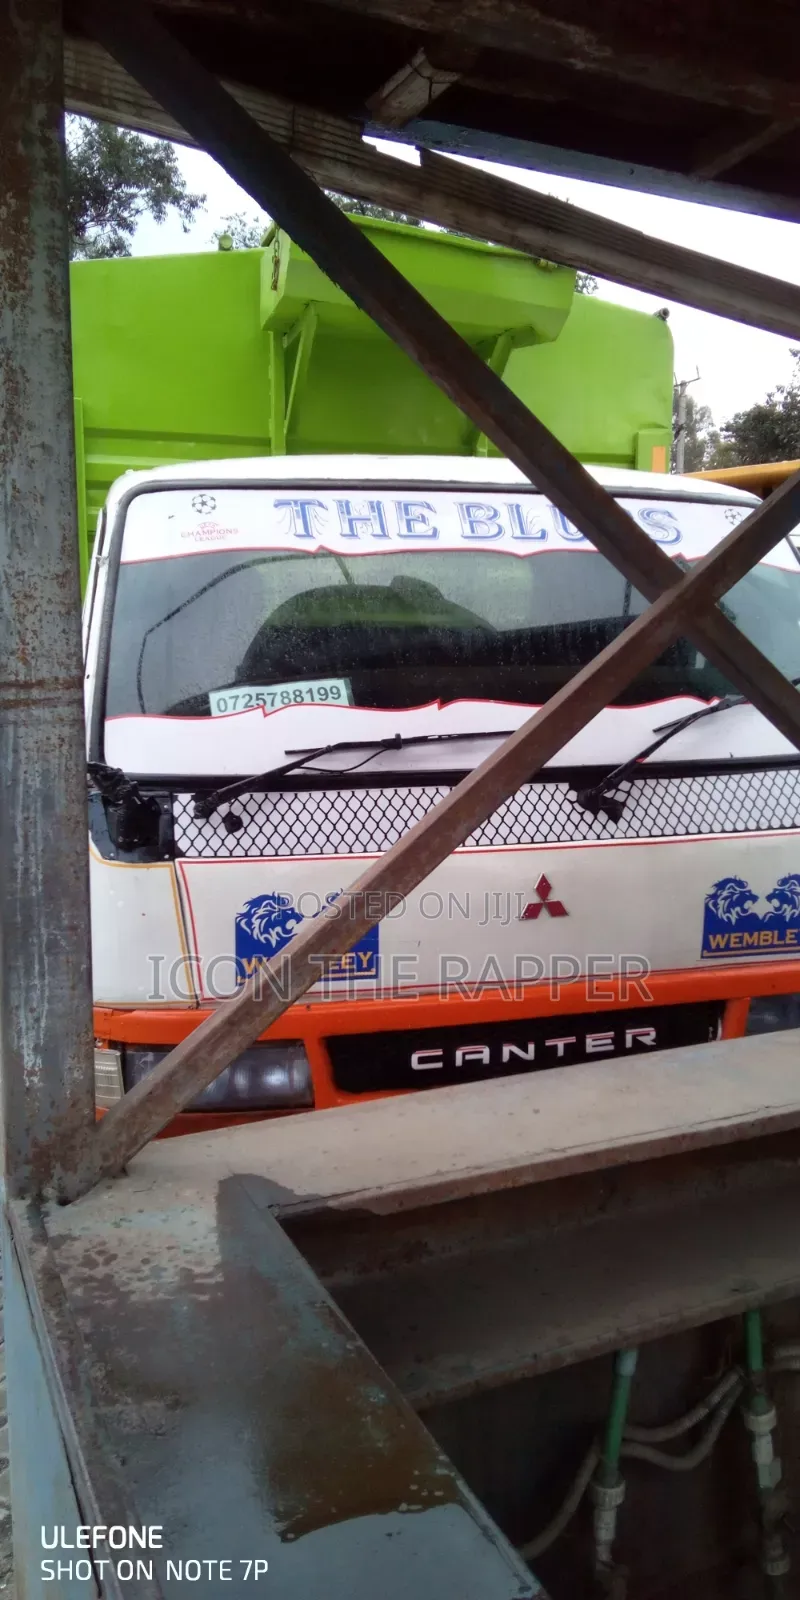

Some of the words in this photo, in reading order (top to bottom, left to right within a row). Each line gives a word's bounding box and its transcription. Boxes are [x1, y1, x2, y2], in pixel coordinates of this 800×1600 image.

[180, 527, 239, 538] CHAMPIONS
[273, 498, 440, 540] THE
[453, 501, 683, 545] BLUS
[216, 685, 342, 713] 0725788199
[708, 929, 800, 950] WEMBLE
[411, 1027, 657, 1070] CANTER
